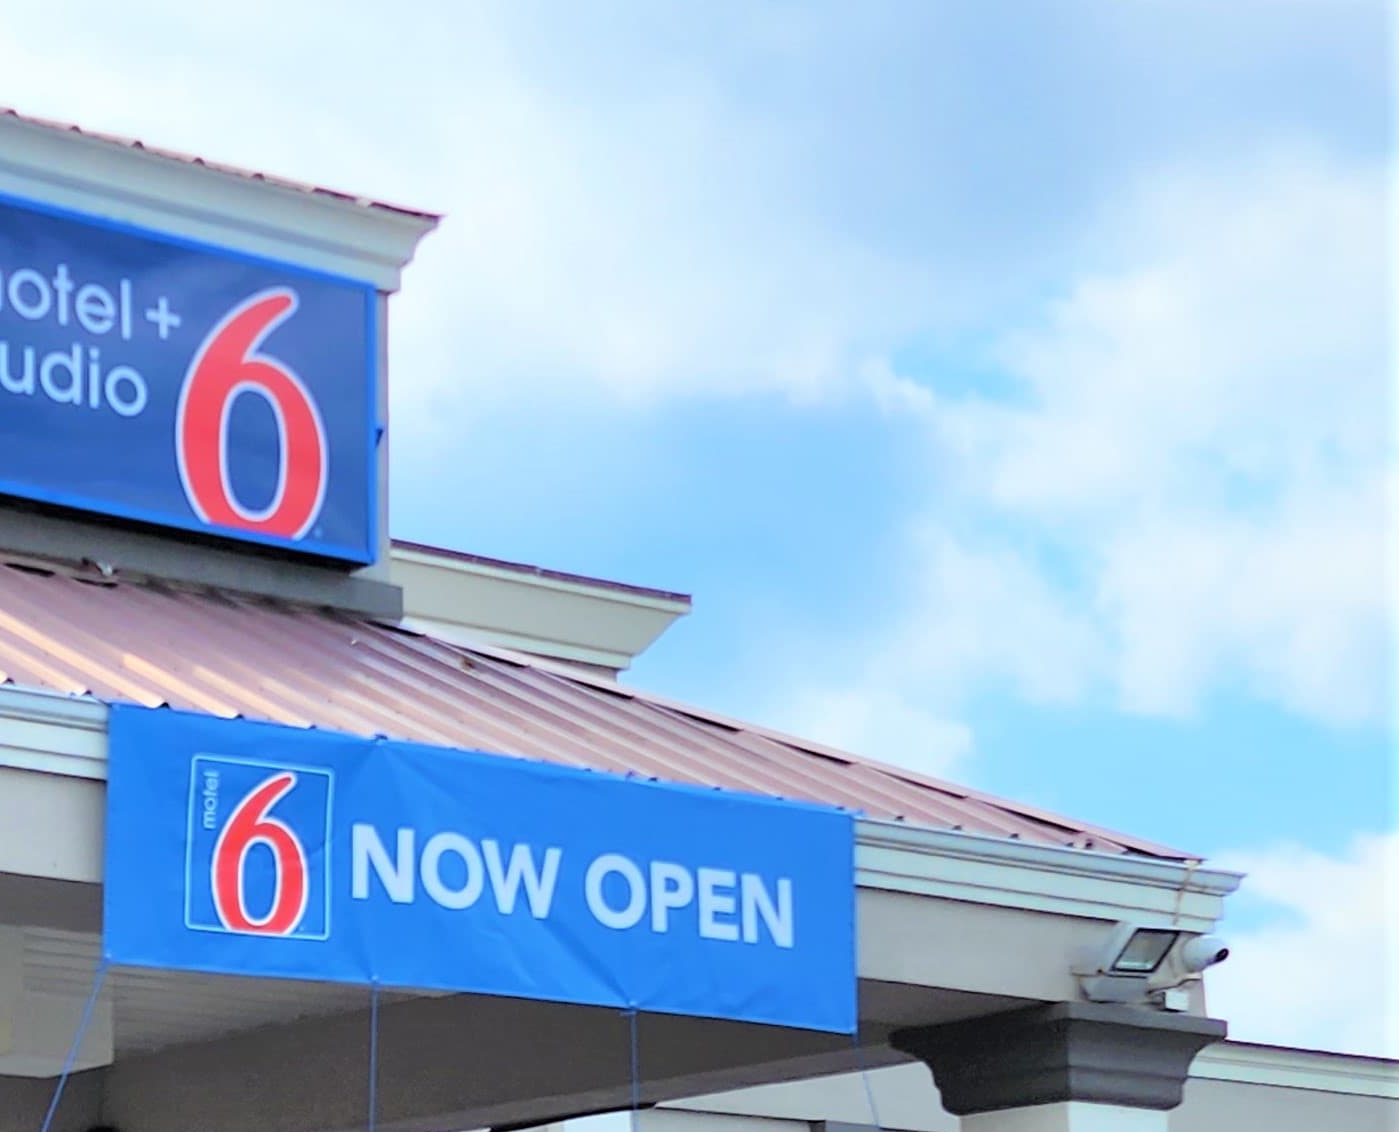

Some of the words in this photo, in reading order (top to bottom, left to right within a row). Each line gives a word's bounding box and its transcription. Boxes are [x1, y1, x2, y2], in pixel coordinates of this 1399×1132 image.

[176, 286, 328, 540] 6
[203, 771, 219, 830] motel
[211, 772, 309, 936] 6
[352, 822, 562, 920] NOW
[585, 854, 794, 949] OPEN
